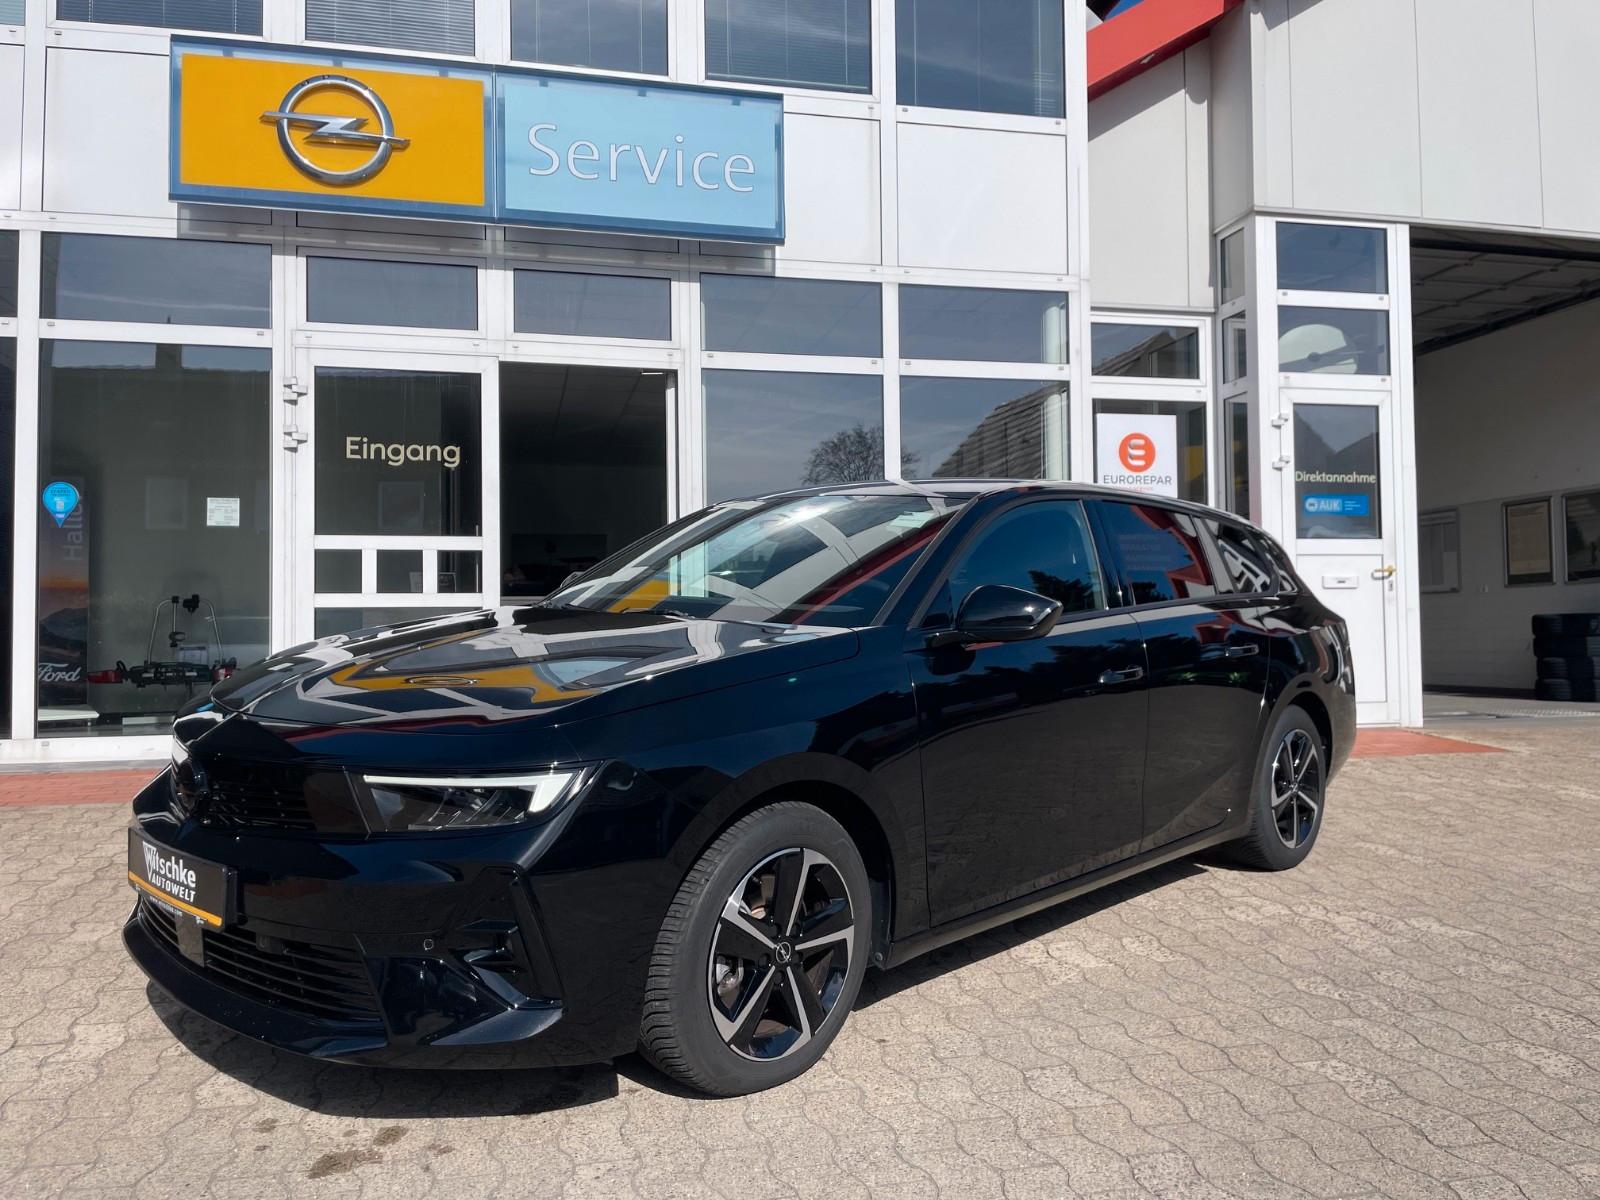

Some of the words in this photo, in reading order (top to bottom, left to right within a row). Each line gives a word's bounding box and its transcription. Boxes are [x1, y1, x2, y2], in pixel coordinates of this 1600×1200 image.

[527, 122, 756, 193] Service
[345, 436, 461, 469] Eingang
[1103, 474, 1173, 486] EUROREPAR
[1294, 470, 1377, 484] Direktannahme
[38, 662, 82, 682] Ford
[142, 840, 197, 888] Witschke
[150, 873, 197, 903] AUTOWELT
